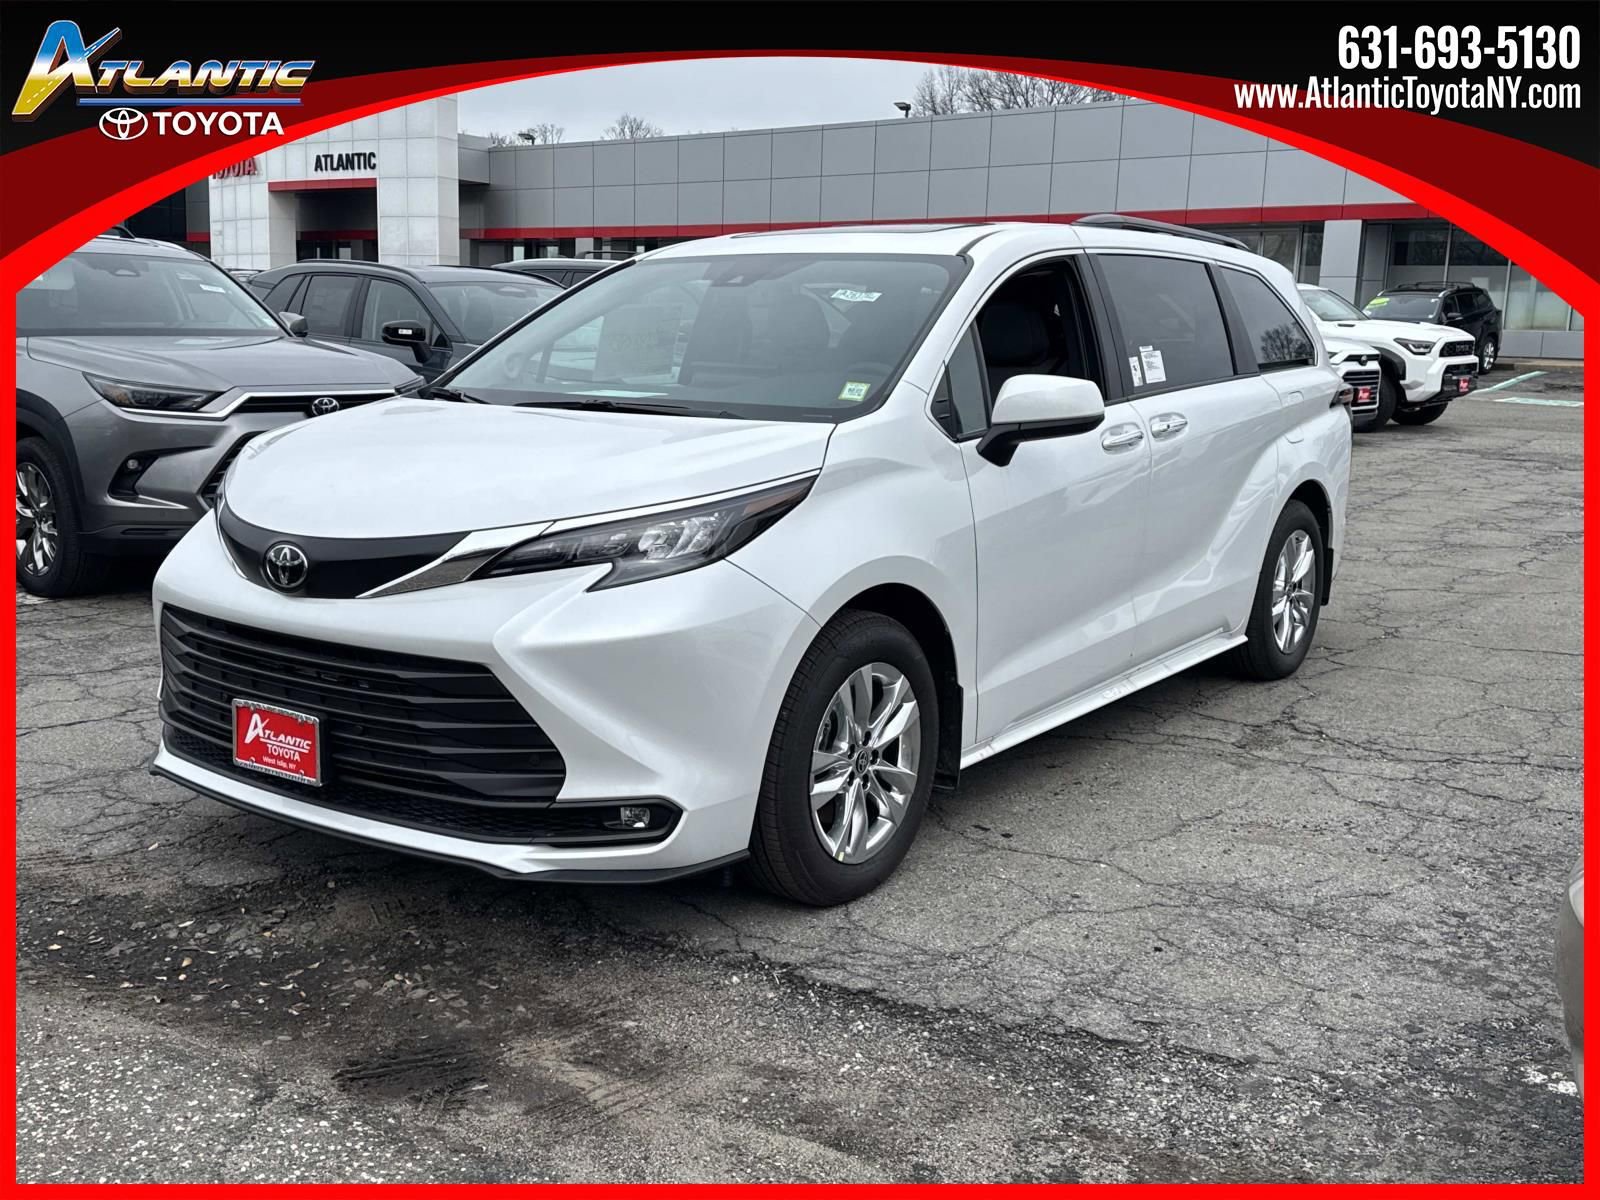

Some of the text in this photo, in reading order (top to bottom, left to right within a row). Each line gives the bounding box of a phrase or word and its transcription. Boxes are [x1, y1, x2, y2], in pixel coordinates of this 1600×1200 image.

[314, 152, 377, 172] ATLANTIC
[244, 713, 312, 750] ATLANTIC
[266, 743, 301, 763] TOYOTA
